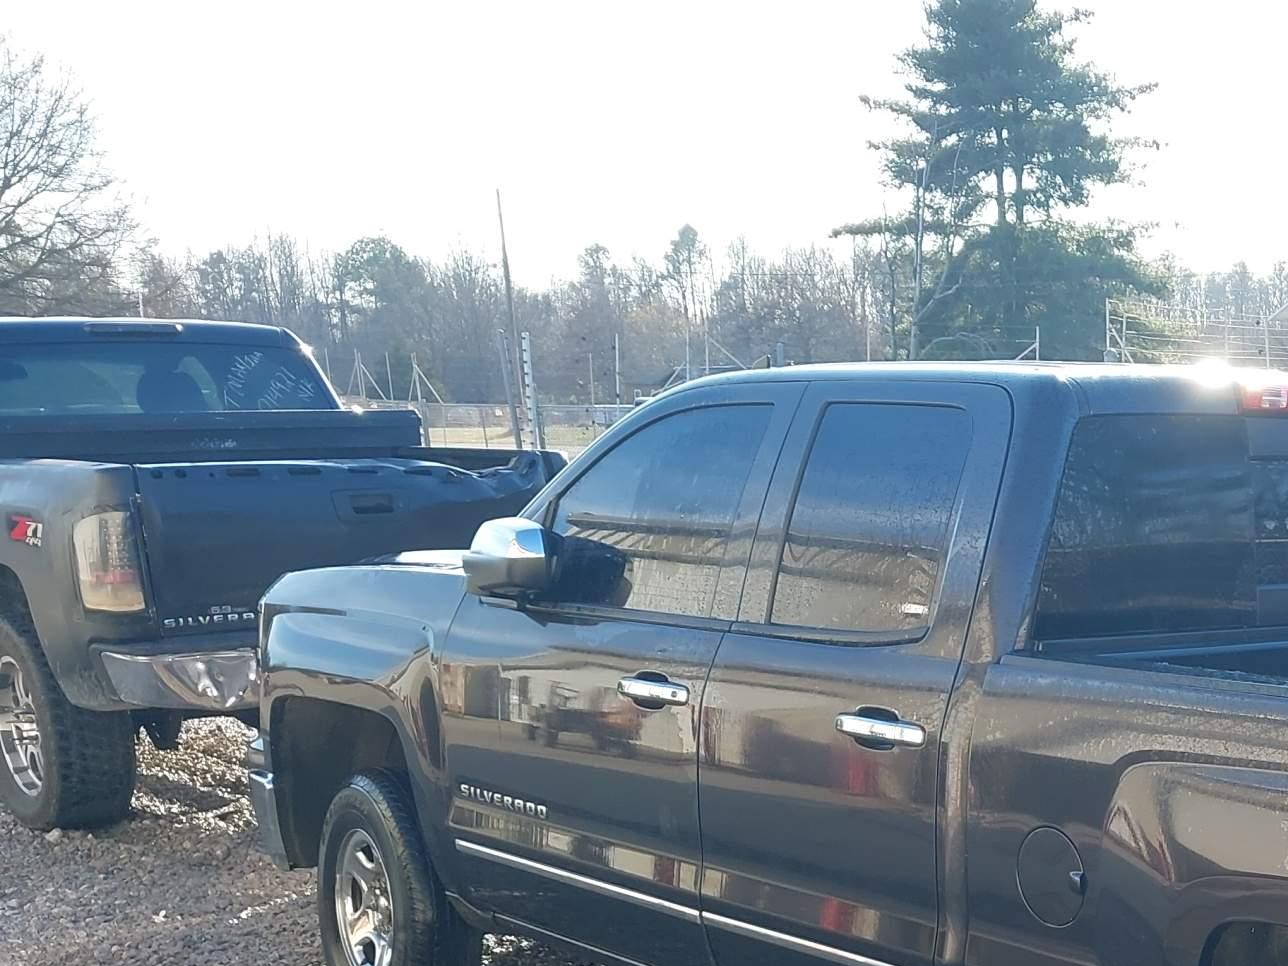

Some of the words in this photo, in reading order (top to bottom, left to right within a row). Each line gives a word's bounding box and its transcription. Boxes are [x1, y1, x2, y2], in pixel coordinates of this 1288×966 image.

[9, 514, 43, 541] Z71
[163, 611, 257, 629] SILVERA
[460, 783, 548, 819] SILVERADO
